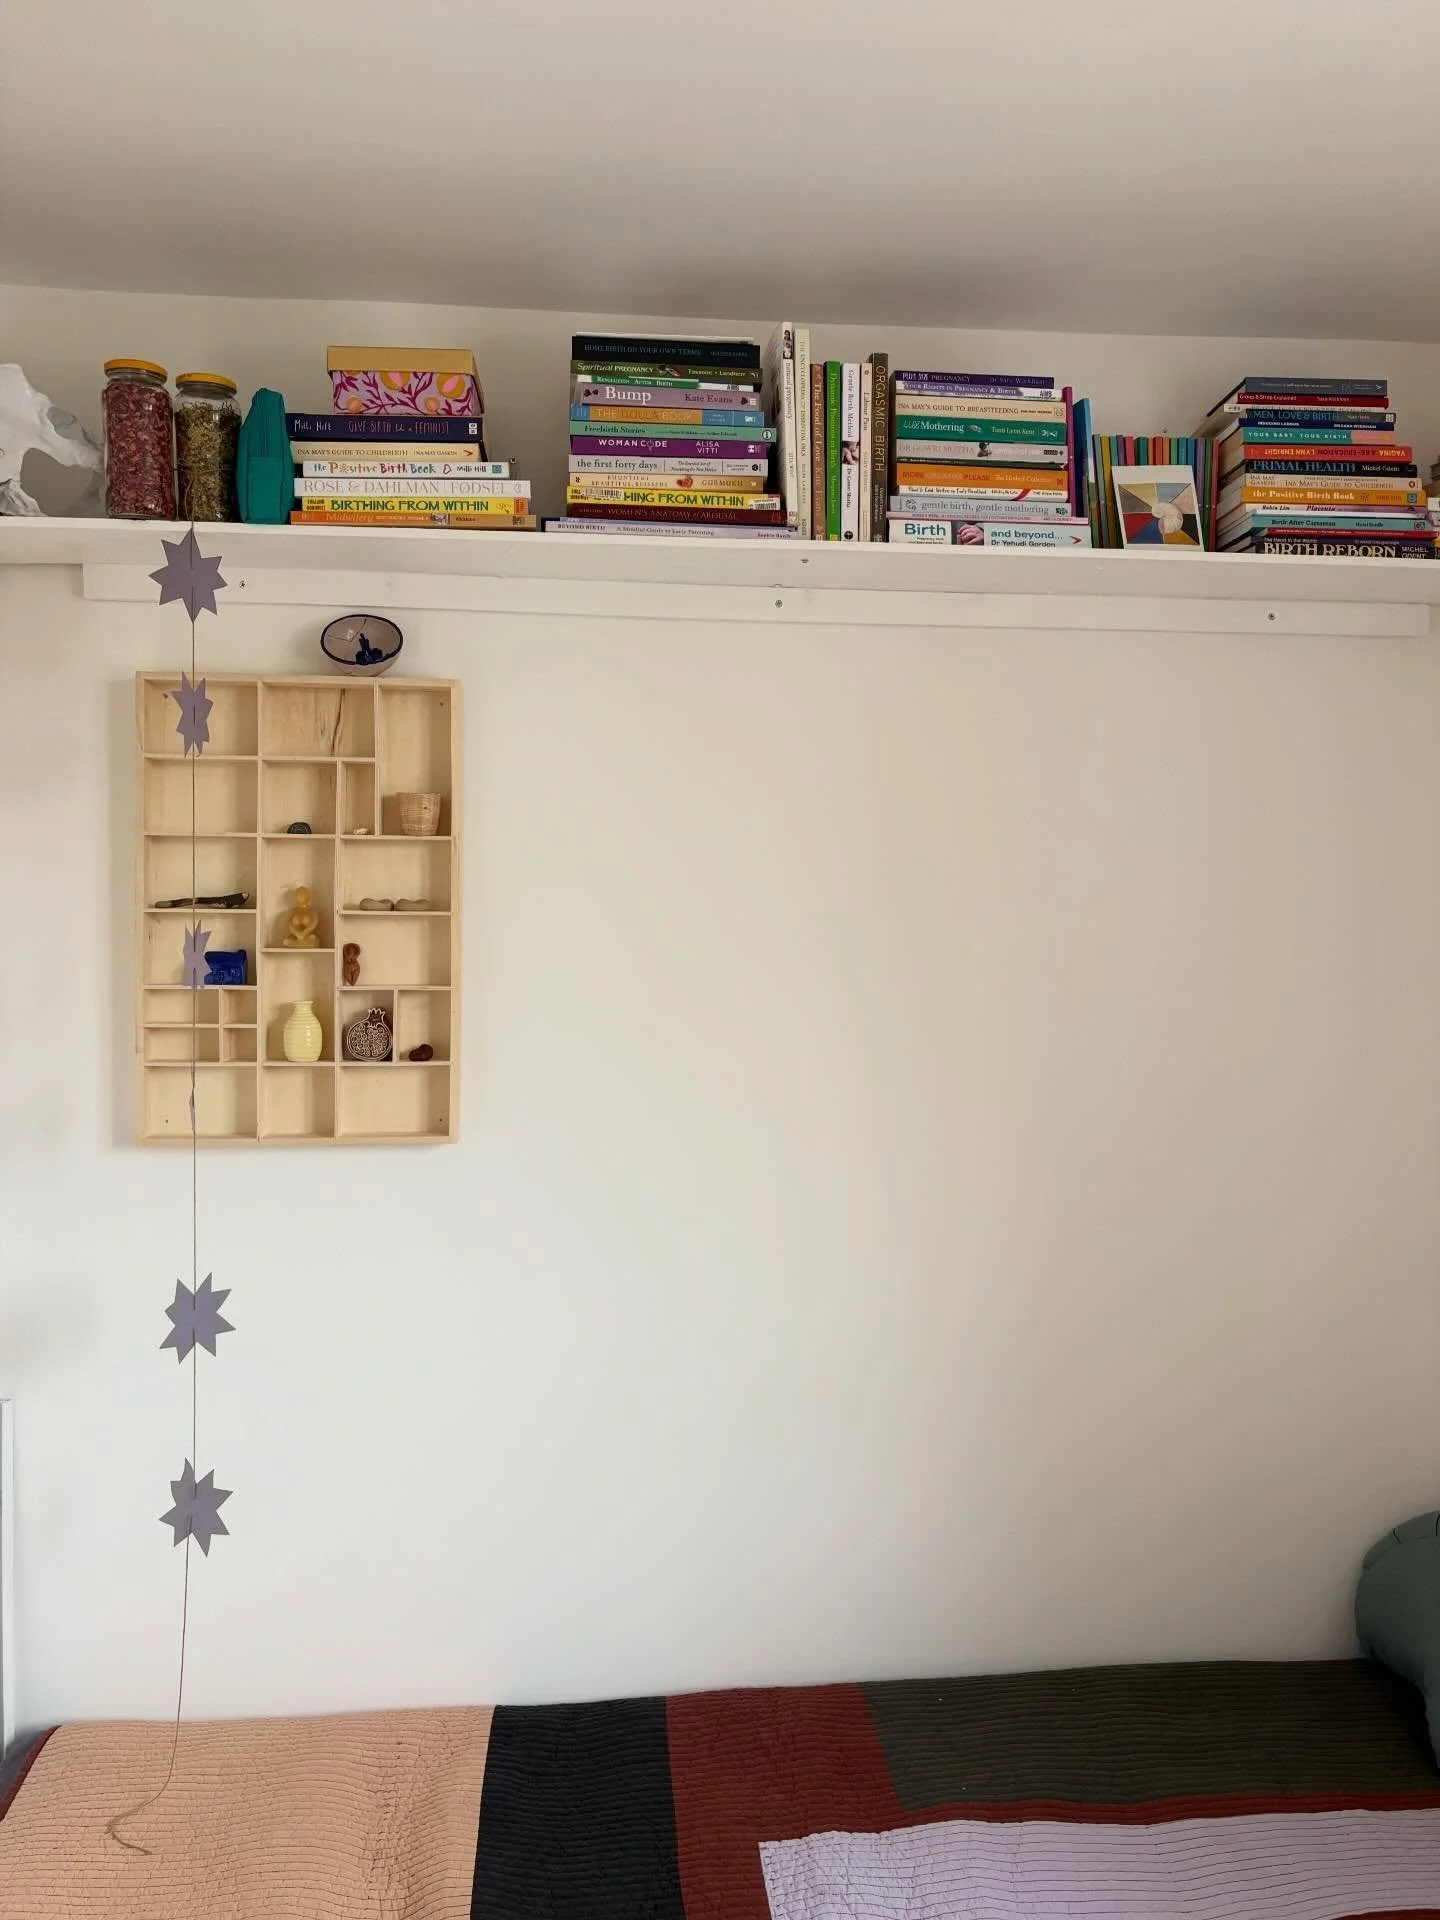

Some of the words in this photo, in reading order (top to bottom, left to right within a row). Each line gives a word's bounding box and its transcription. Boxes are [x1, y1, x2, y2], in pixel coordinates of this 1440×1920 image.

[577, 362, 613, 372] Spiritual
[615, 364, 653, 373] PREGNANCY
[605, 386, 651, 405] Bump
[685, 394, 704, 402] Kate
[708, 394, 733, 403] Evans
[875, 366, 885, 428] ORGASMIC
[1312, 412, 1338, 420] BIRTH
[294, 419, 312, 433] Milli
[317, 420, 332, 431] Hill
[348, 420, 366, 432] GIVE
[371, 421, 391, 433] BIRTH
[415, 421, 449, 434] FEMINIST
[920, 421, 964, 433] Mothering
[875, 436, 885, 471] BIRTH
[314, 464, 326, 473] the
[328, 462, 377, 474] Positive
[380, 463, 407, 474] Birth
[410, 463, 436, 474] Book
[577, 459, 591, 467] the
[595, 460, 612, 468] first
[615, 460, 635, 471] forty
[639, 460, 657, 471] days
[1254, 461, 1303, 471] PRIMAL
[1307, 462, 1356, 472] HEALTH
[304, 481, 343, 492] ROSE
[364, 482, 439, 494] DAHLMAN
[330, 500, 394, 511] BIRTHING
[399, 500, 439, 511] FROM
[443, 501, 489, 511] WITHIN
[659, 494, 697, 504] FROM
[700, 496, 744, 506] WITHIN
[922, 501, 948, 510] gentle
[950, 502, 973, 512] birth,
[976, 503, 1003, 512] gentle
[1004, 506, 1049, 515] mothering
[326, 513, 374, 522] Midwifery
[904, 524, 946, 536] Birth
[1264, 542, 1317, 554] BIRTH
[1322, 544, 1396, 557] REBORN
